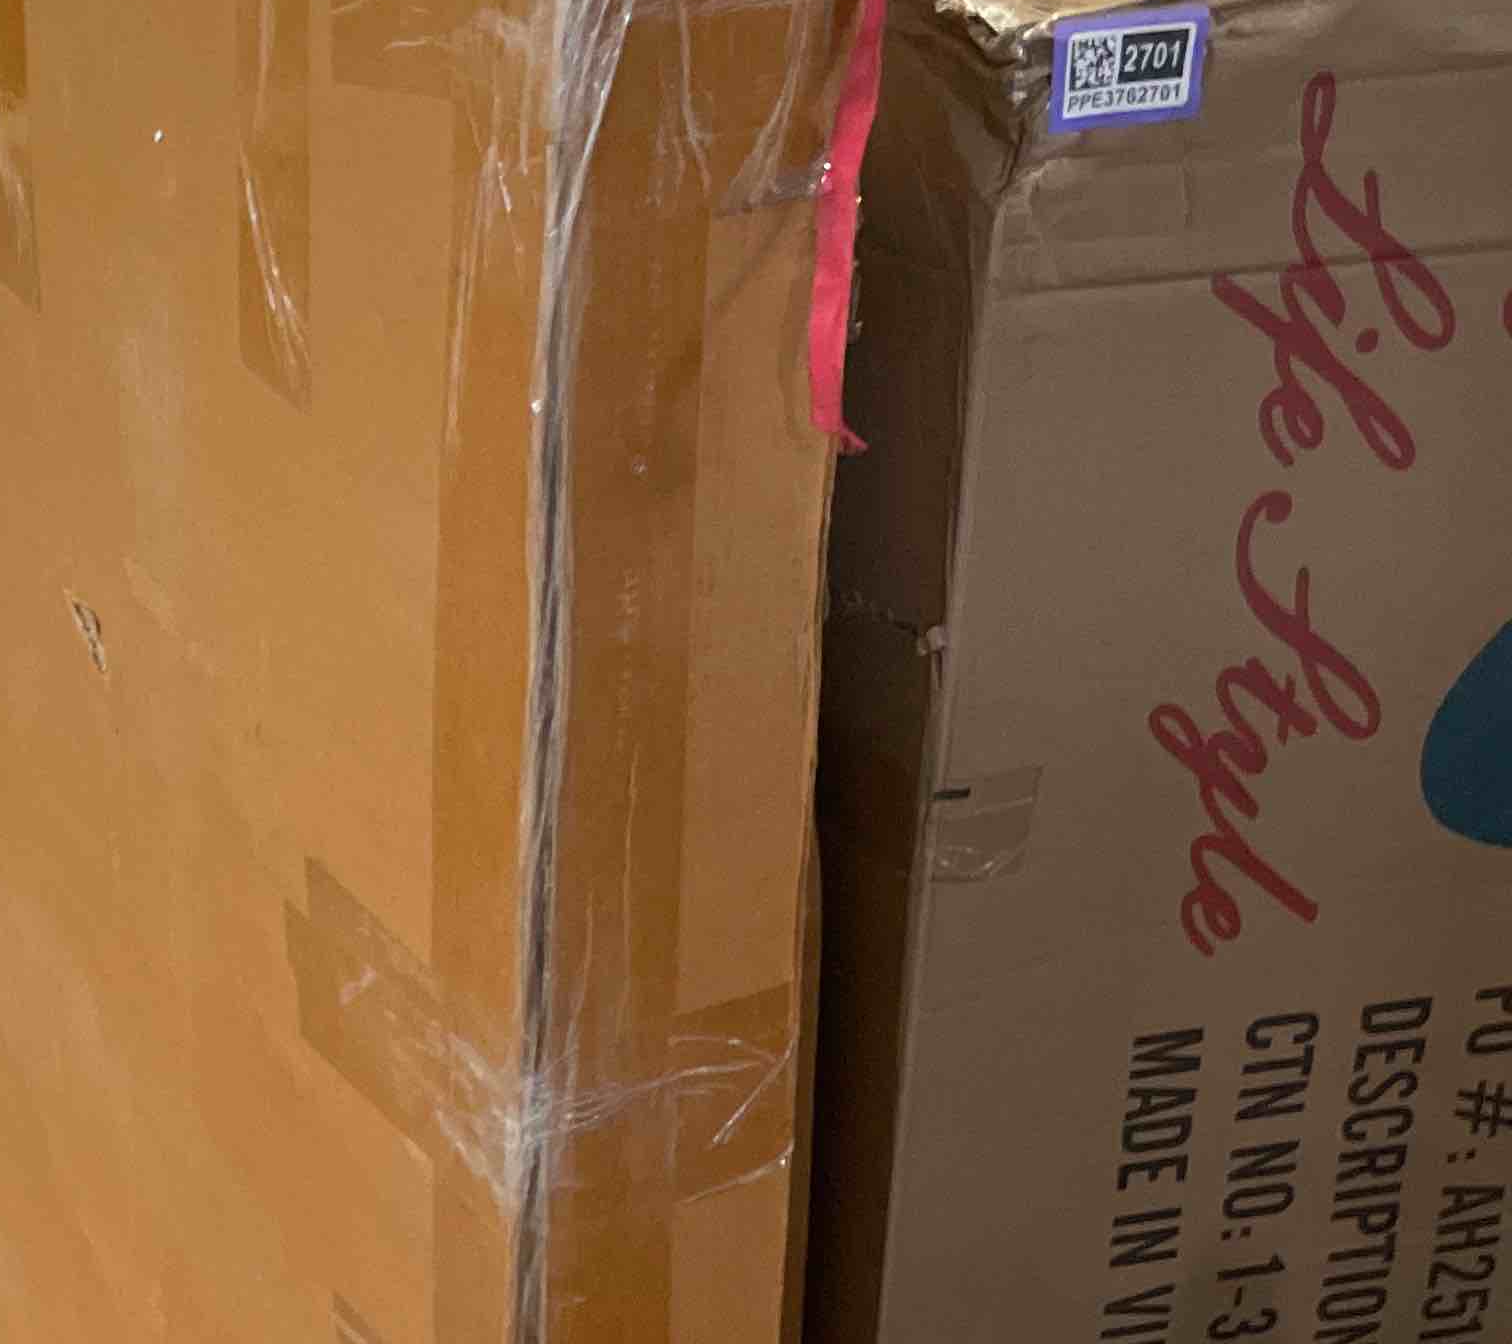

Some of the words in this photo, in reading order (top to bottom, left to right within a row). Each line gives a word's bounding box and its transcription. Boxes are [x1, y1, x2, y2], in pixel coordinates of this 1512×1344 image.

[1123, 40, 1181, 73] 2701
[1212, 71, 1455, 471] Life
[1149, 491, 1381, 956] Style
[1116, 1027, 1204, 1192] MADE
[1234, 1013, 1320, 1123] CTN
[1108, 1207, 1183, 1269] IN
[1220, 1138, 1301, 1241] NO:
[1205, 1252, 1286, 1343] 1-3
